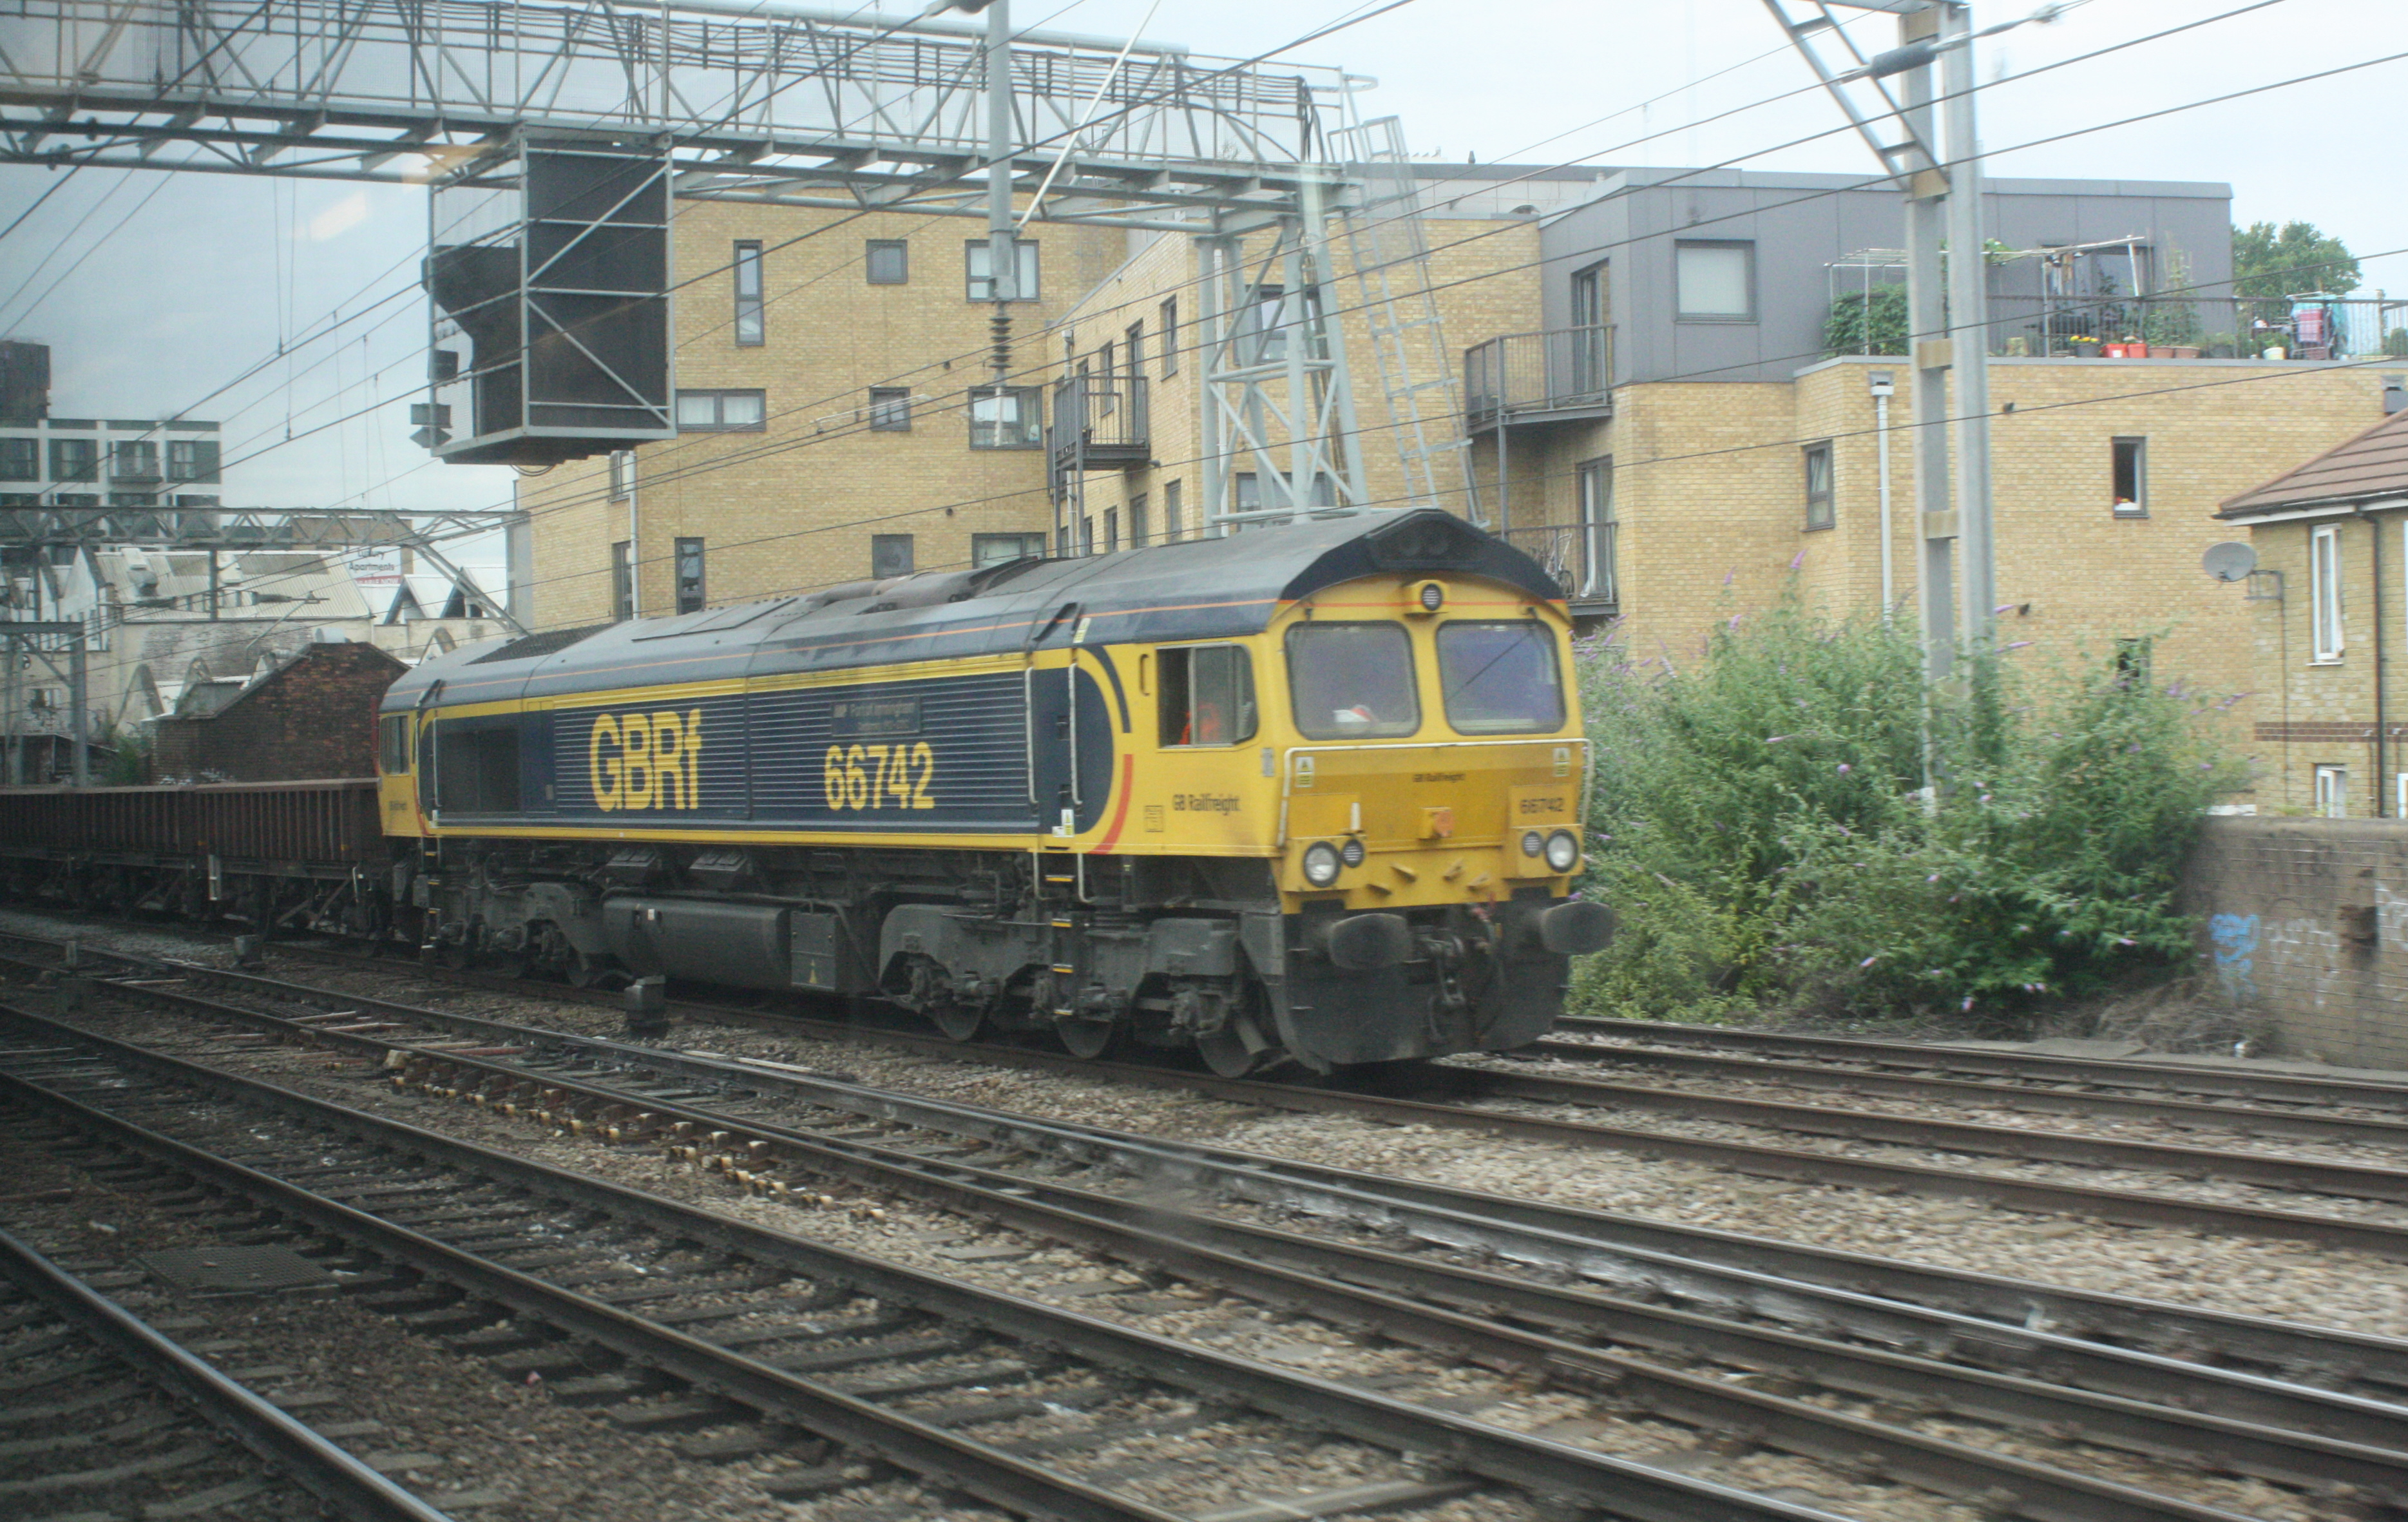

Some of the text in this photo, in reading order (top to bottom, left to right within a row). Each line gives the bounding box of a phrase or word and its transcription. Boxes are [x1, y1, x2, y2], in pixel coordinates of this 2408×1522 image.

[349, 562, 394, 573] Apartments
[590, 708, 702, 812] GBRf
[825, 742, 935, 811] 66742
[1172, 793, 1241, 816] GB Railfreight
[1520, 797, 1565, 814] 66742
